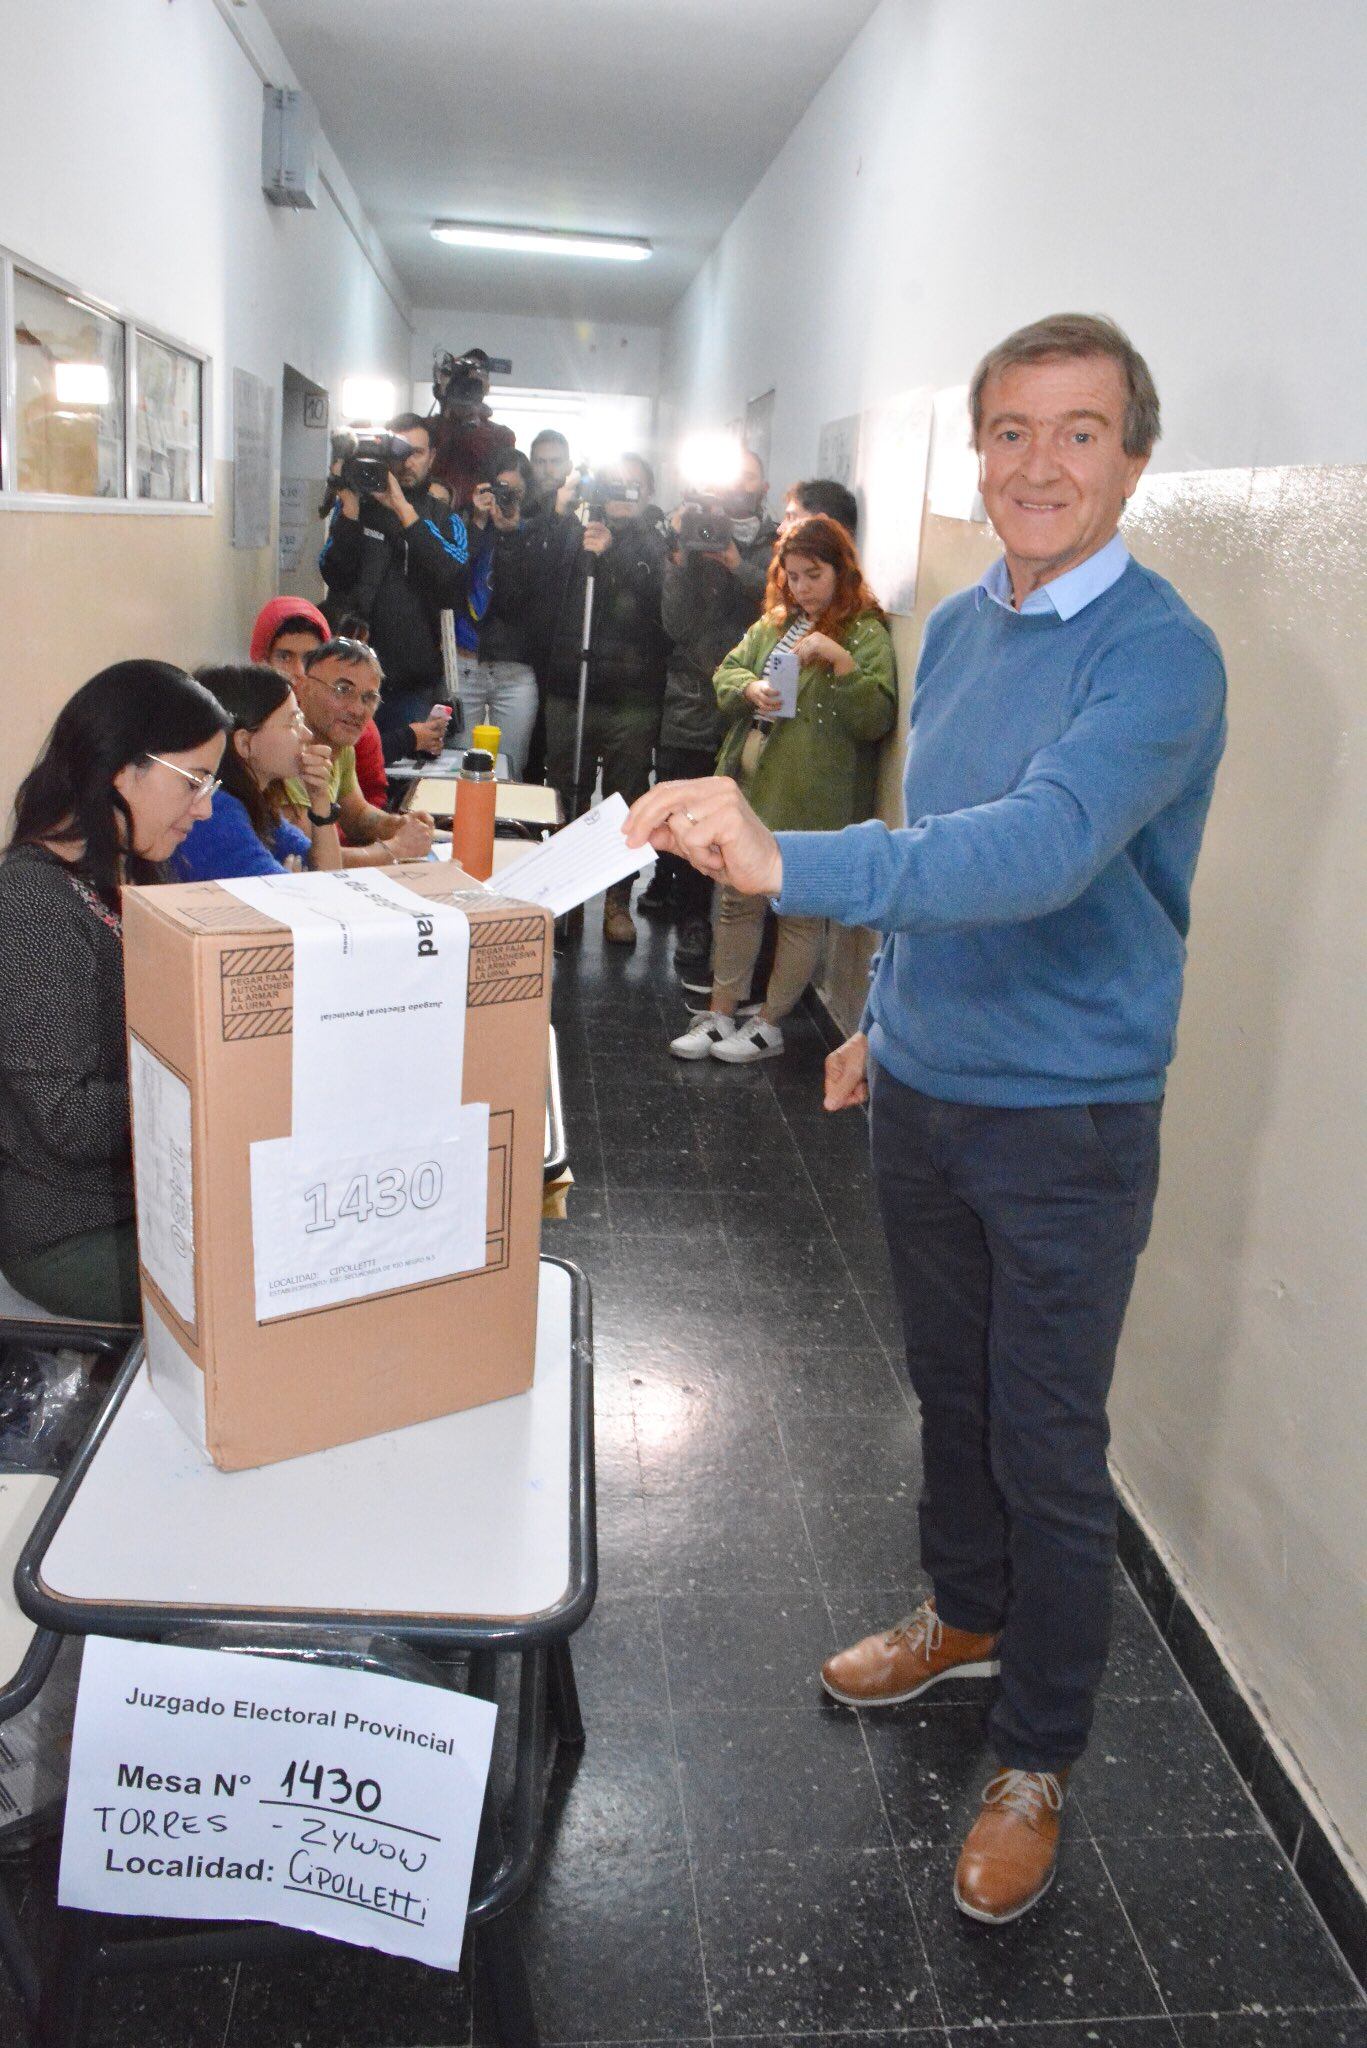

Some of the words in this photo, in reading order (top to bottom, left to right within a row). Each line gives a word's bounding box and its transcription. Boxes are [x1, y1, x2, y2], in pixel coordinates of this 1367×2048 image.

[320, 1011, 364, 1021] Provincial
[366, 1006, 406, 1017] Electoral
[408, 1001, 443, 1012] Juzgado
[303, 1160, 443, 1234] 1430
[268, 1272, 320, 1289] LOCALIDAD:
[125, 1687, 225, 1715] Juzgado
[233, 1700, 336, 1727] Electoral
[343, 1712, 454, 1756] Provincial
[117, 1763, 201, 1795] Mesa
[213, 1773, 251, 1797] N°
[280, 1759, 382, 1813] 1430
[93, 1807, 228, 1839] TORRES
[105, 1849, 274, 1882] Localidad:
